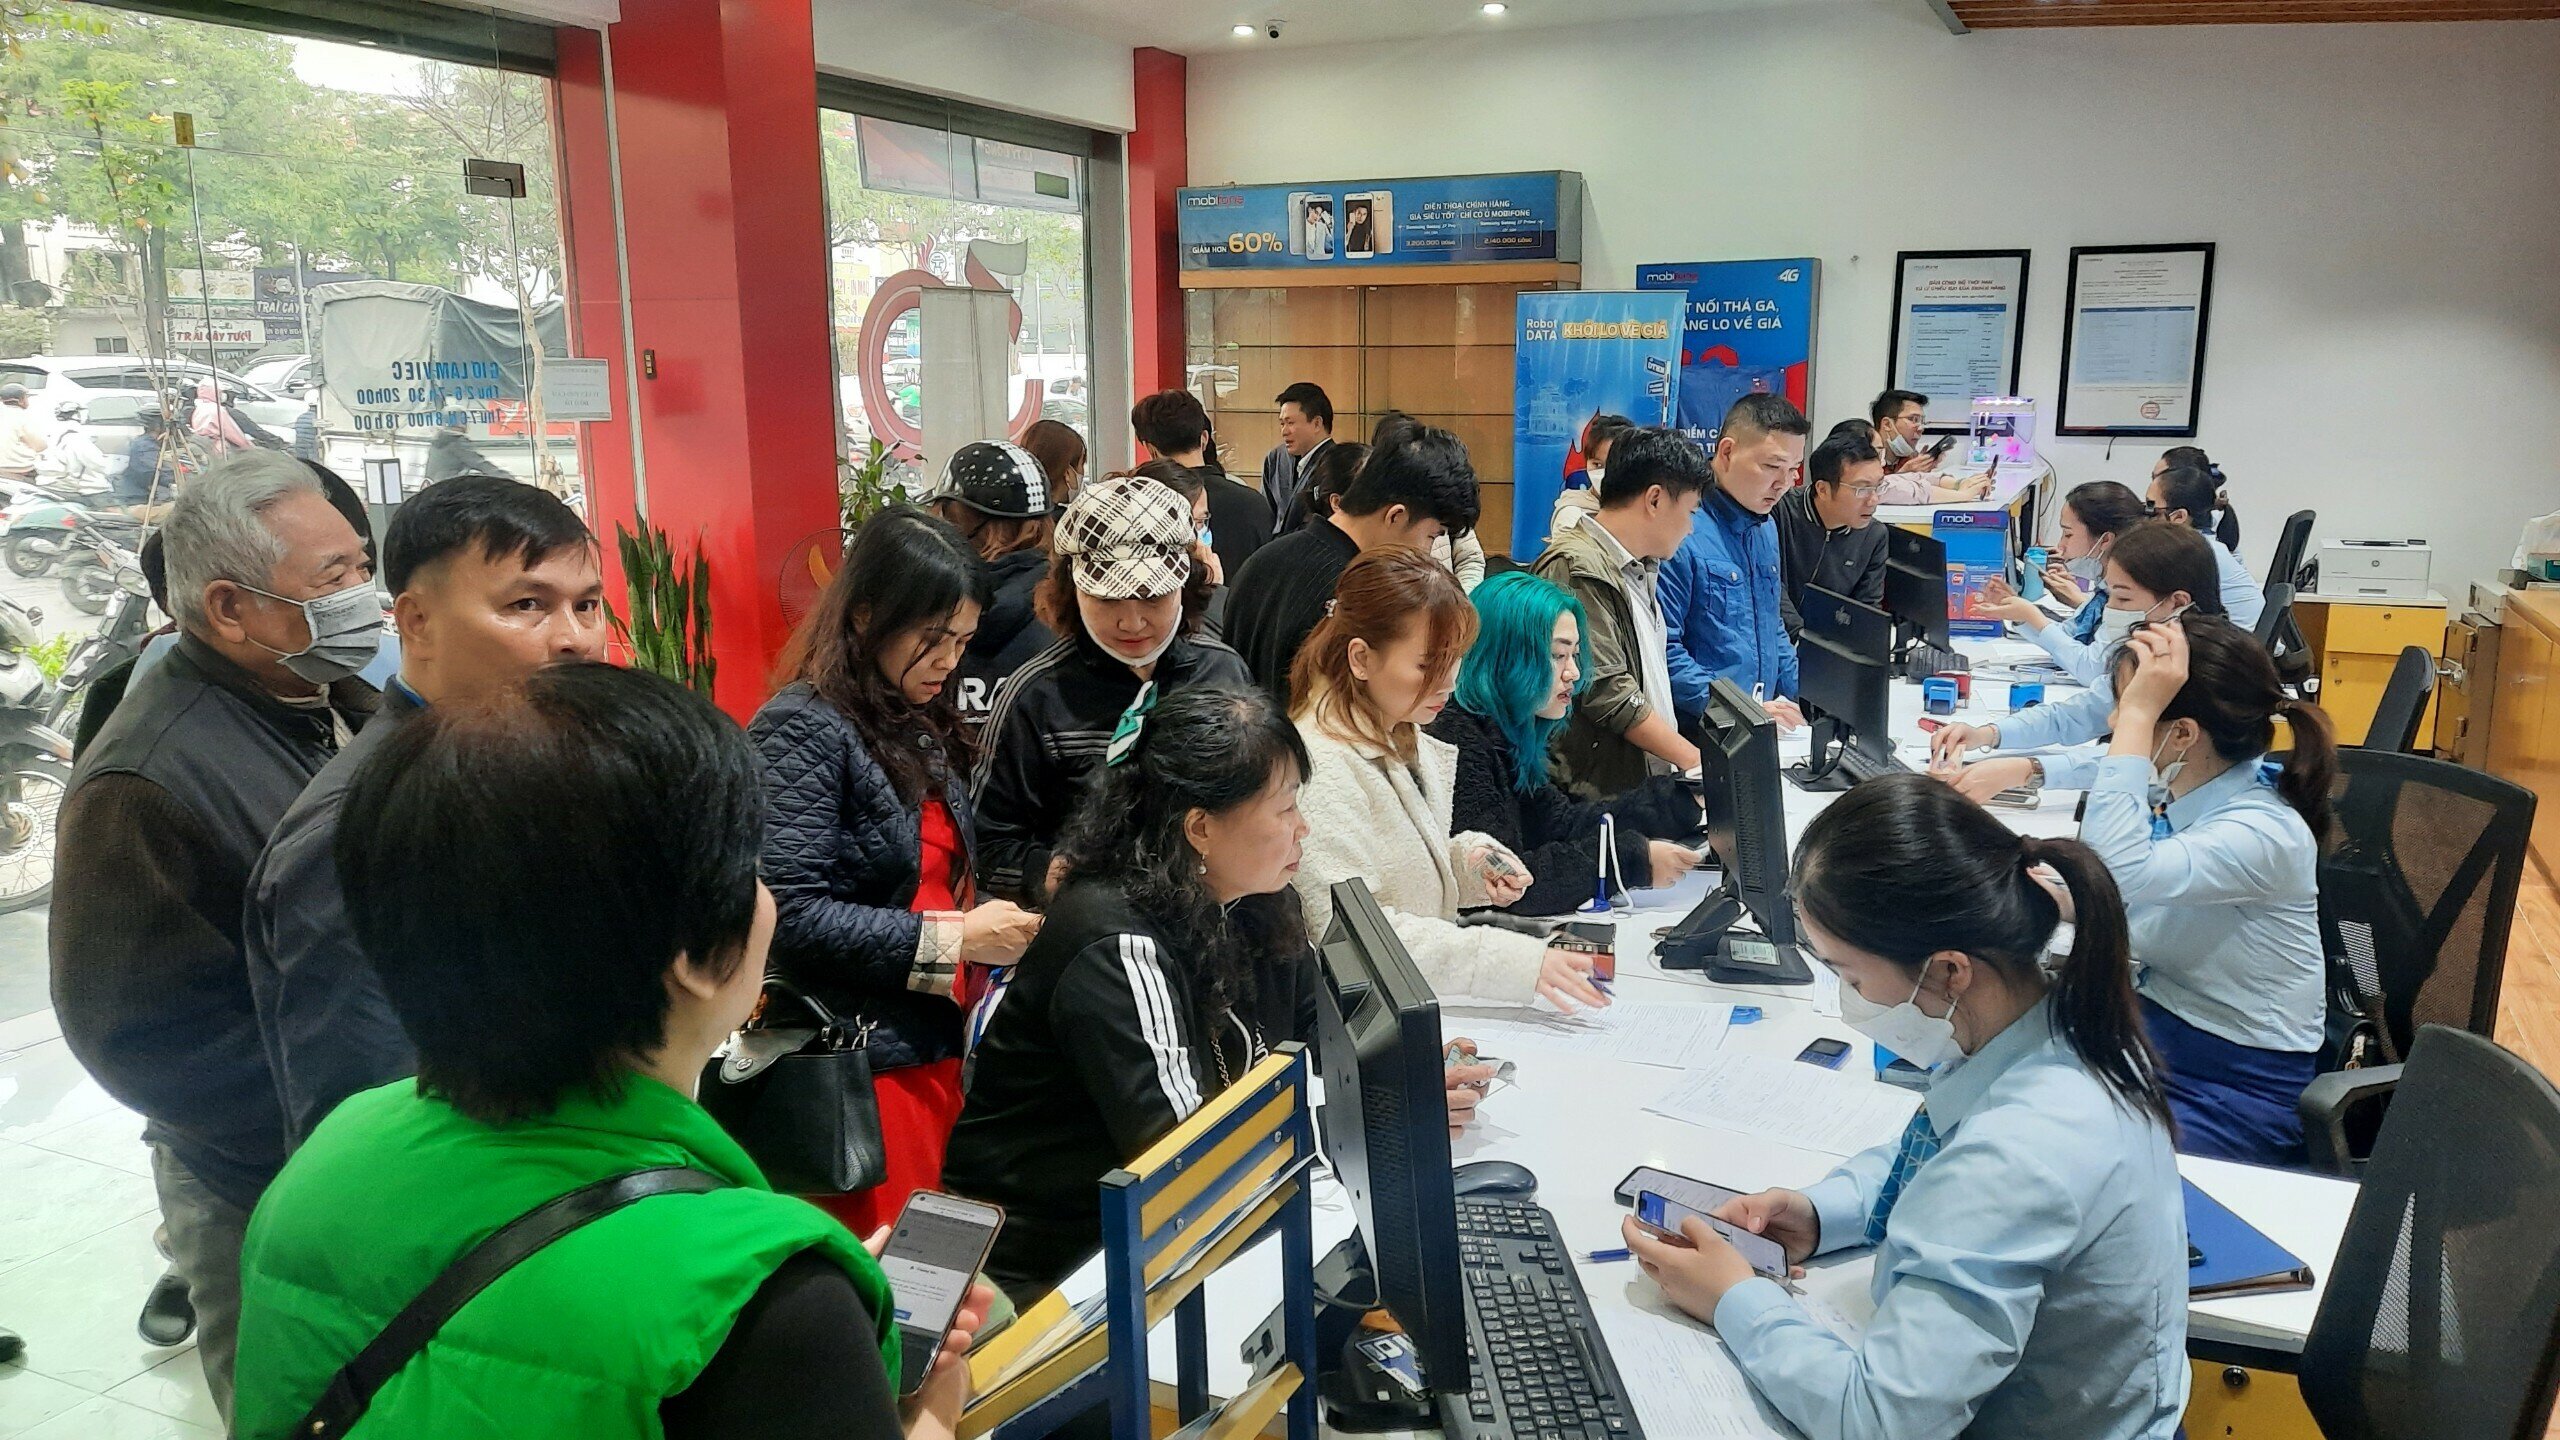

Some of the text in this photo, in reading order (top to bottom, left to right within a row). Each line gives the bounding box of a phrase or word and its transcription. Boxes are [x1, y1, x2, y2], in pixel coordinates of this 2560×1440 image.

[1229, 231, 1283, 254] 60%
[1778, 268, 1800, 282] 4G
[1696, 298, 1719, 313] NỐI
[1755, 299, 1780, 313] GA,
[1526, 318, 1558, 329] Robot
[1599, 322, 1618, 338] LO
[1641, 320, 1668, 338] GIÁ
[1712, 319, 1730, 331] LO
[1734, 315, 1753, 330] VỀ
[1757, 314, 1783, 329] GIÁ
[1526, 329, 1558, 341] DATA
